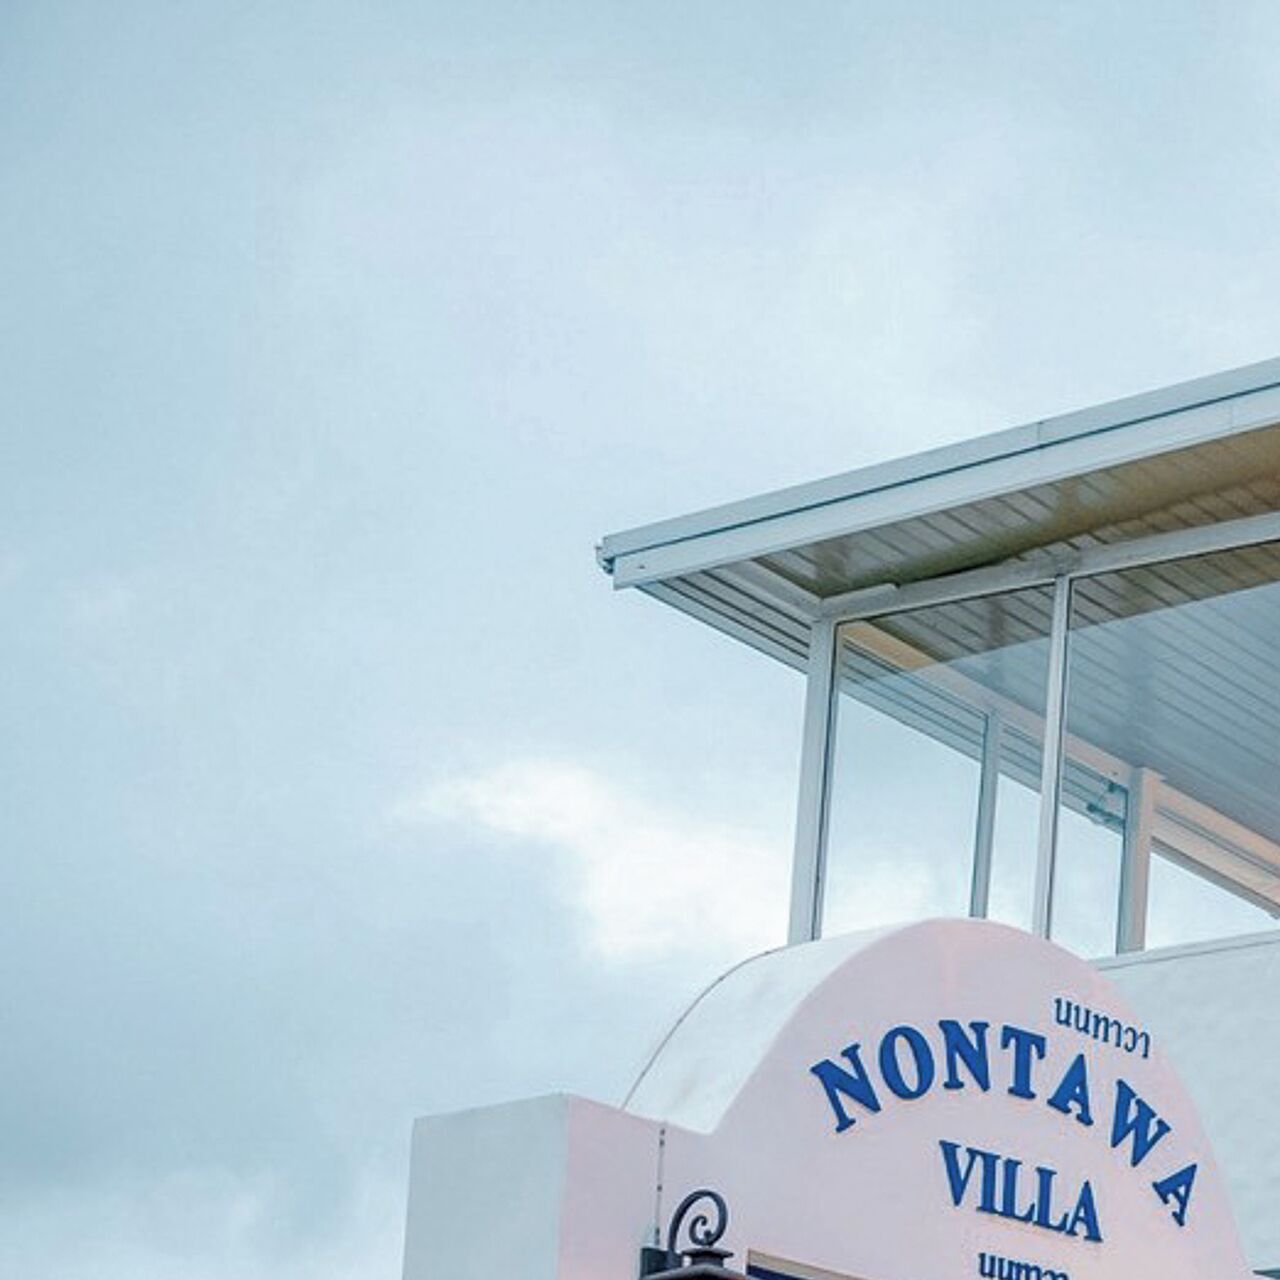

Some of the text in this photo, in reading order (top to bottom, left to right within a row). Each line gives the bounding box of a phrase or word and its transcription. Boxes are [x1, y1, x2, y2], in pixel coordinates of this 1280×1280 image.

[1054, 998, 1150, 1059] นนทาวา
[810, 1019, 1198, 1227] NONTAWA
[939, 1140, 1103, 1243] VILLA
